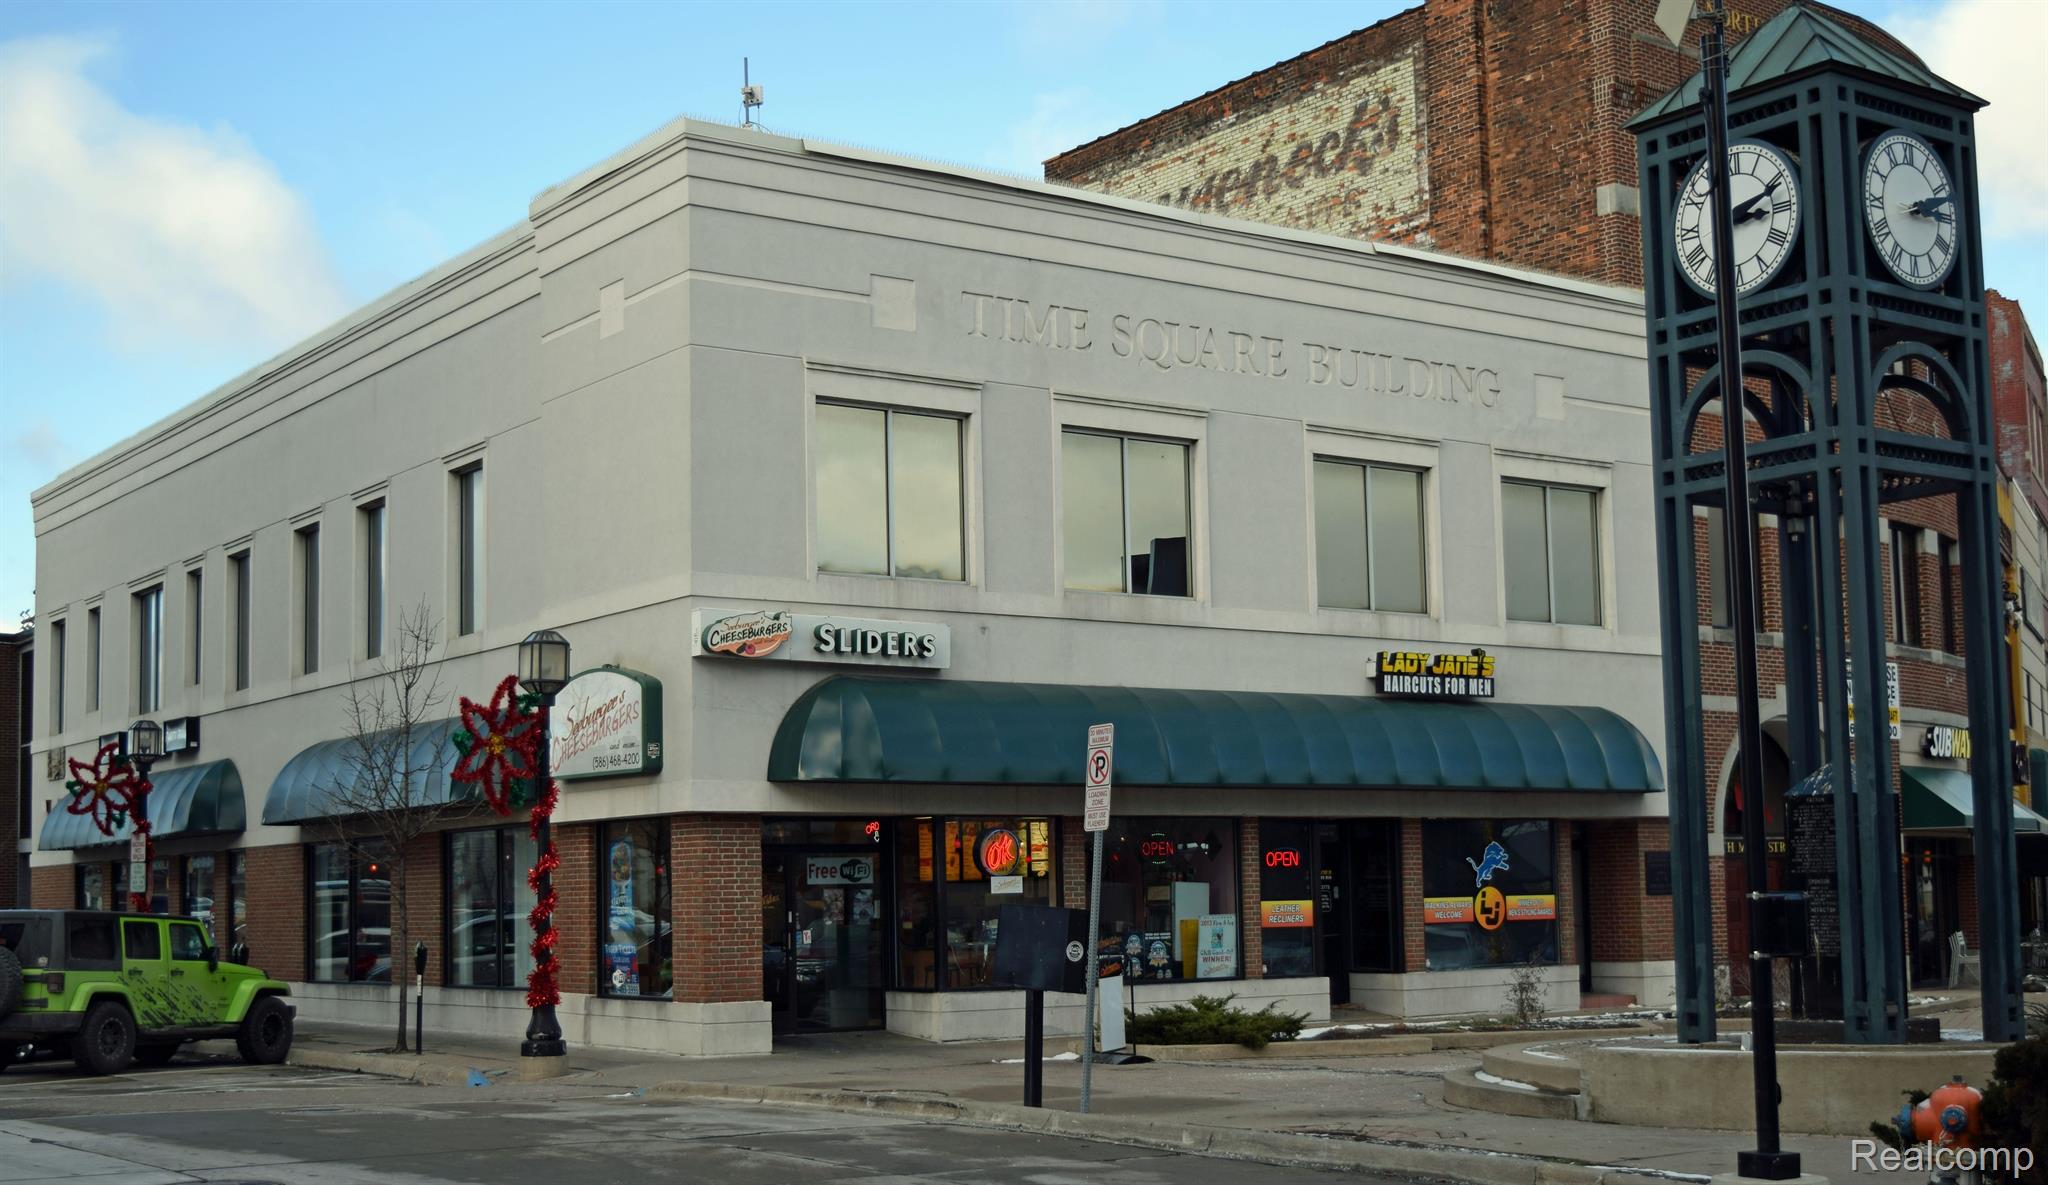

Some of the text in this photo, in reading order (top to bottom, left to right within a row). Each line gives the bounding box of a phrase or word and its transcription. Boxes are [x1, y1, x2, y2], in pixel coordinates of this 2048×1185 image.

[961, 291, 1502, 408] TIME SQUARE BUILDING
[710, 622, 788, 647] CHEESEBURGERS
[816, 623, 936, 658] SLIDERS
[1381, 649, 1496, 677] LADY JANE'S
[1383, 674, 1491, 696] HAIRCUTS FOR MEN
[552, 700, 640, 772] CHEESEBURGERS
[1088, 790, 1108, 799] LOADING
[1091, 798, 1104, 807] ZONE
[1142, 841, 1175, 856] OPEN
[1266, 851, 1299, 867] OPEN
[808, 864, 837, 879] Free
[1271, 904, 1301, 913] LEATHER
[1434, 911, 1463, 919] WELCOME
[1268, 914, 1304, 924] RECLINERS
[1202, 955, 1232, 963] WINNER!
